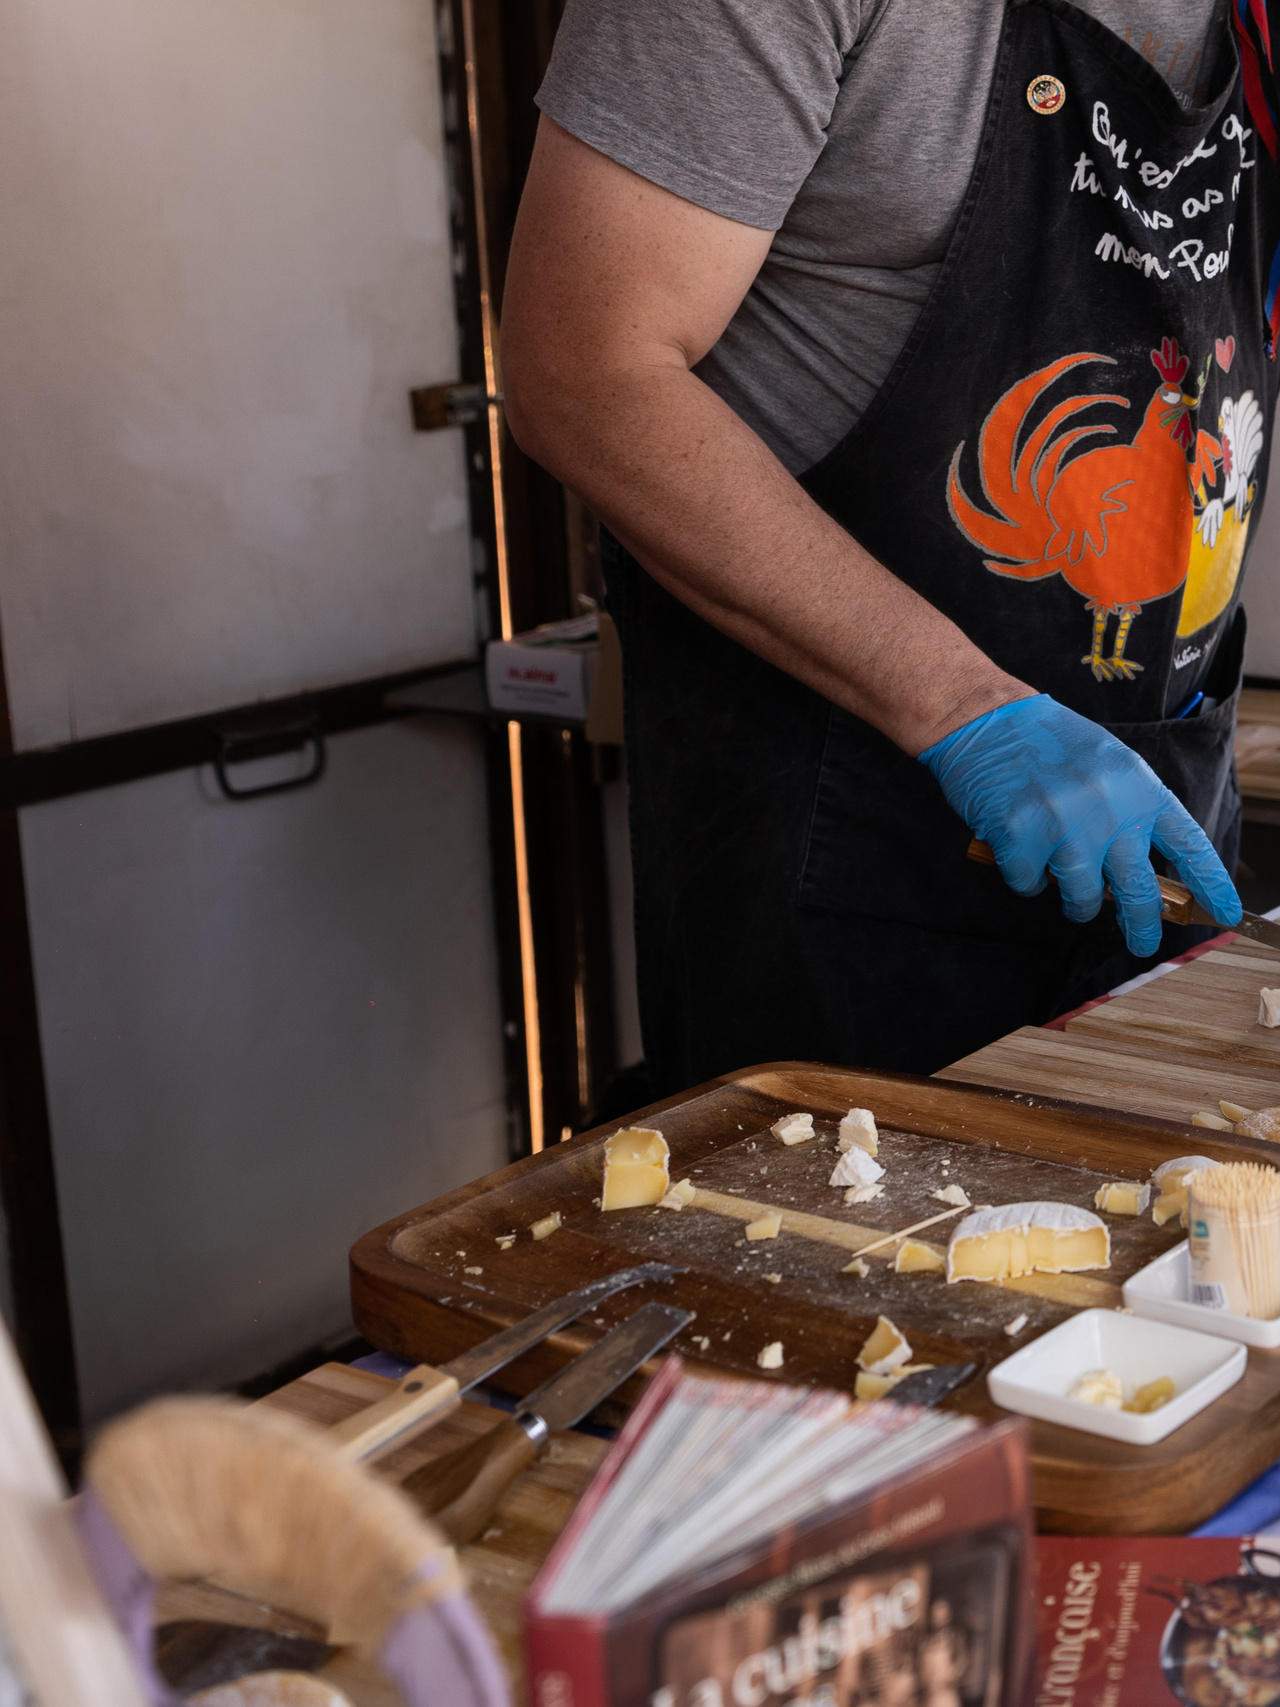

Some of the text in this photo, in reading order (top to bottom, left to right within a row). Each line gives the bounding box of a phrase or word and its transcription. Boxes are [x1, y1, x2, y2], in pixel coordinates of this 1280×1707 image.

[1070, 151, 1107, 197] tu
[1182, 188, 1224, 219] as
[1094, 232, 1170, 280] mon
